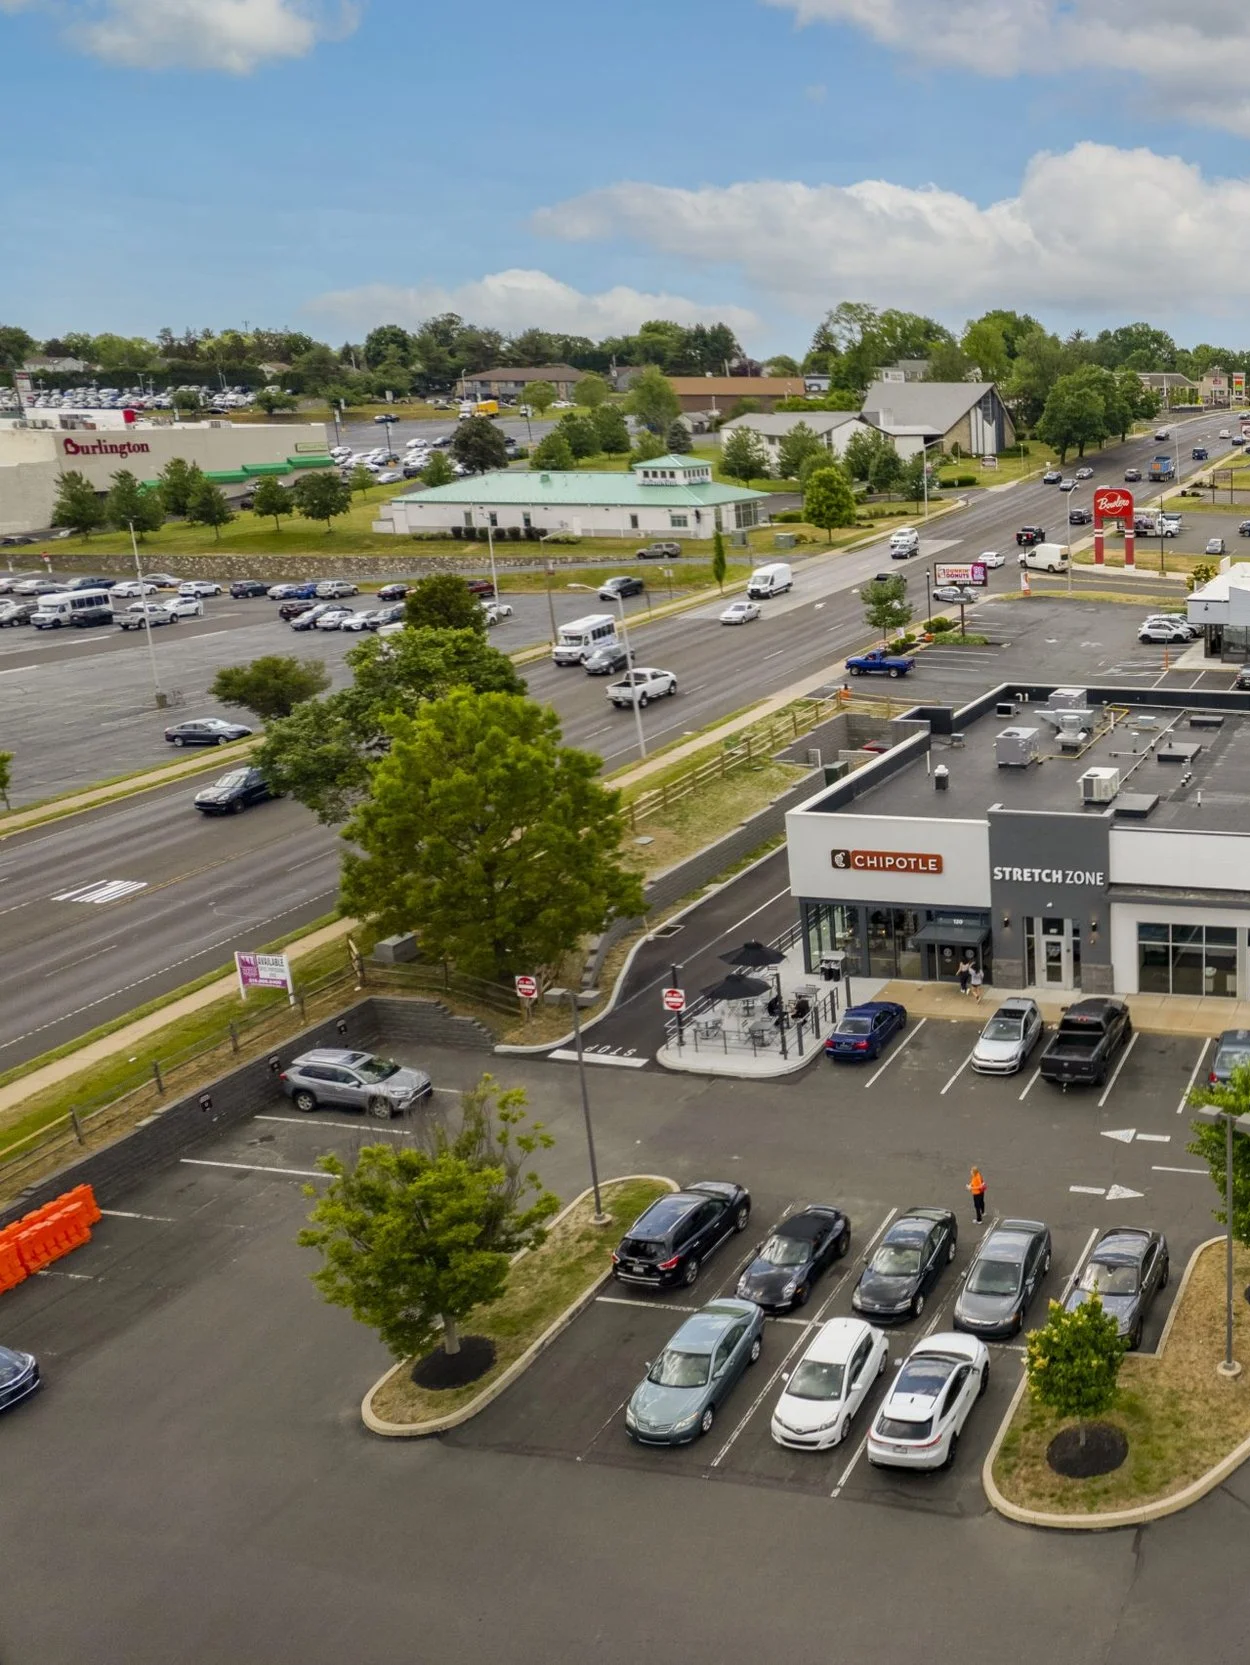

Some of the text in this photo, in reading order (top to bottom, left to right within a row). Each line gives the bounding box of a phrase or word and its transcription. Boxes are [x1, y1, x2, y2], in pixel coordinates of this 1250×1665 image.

[64, 438, 150, 459] Burlington
[1097, 495, 1130, 510] Bowlero
[854, 855, 938, 871] CHIPOTLE
[993, 866, 1105, 886] STRETCH ZONE
[257, 956, 285, 967] AVAILABLE
[583, 1044, 637, 1057] STOP
